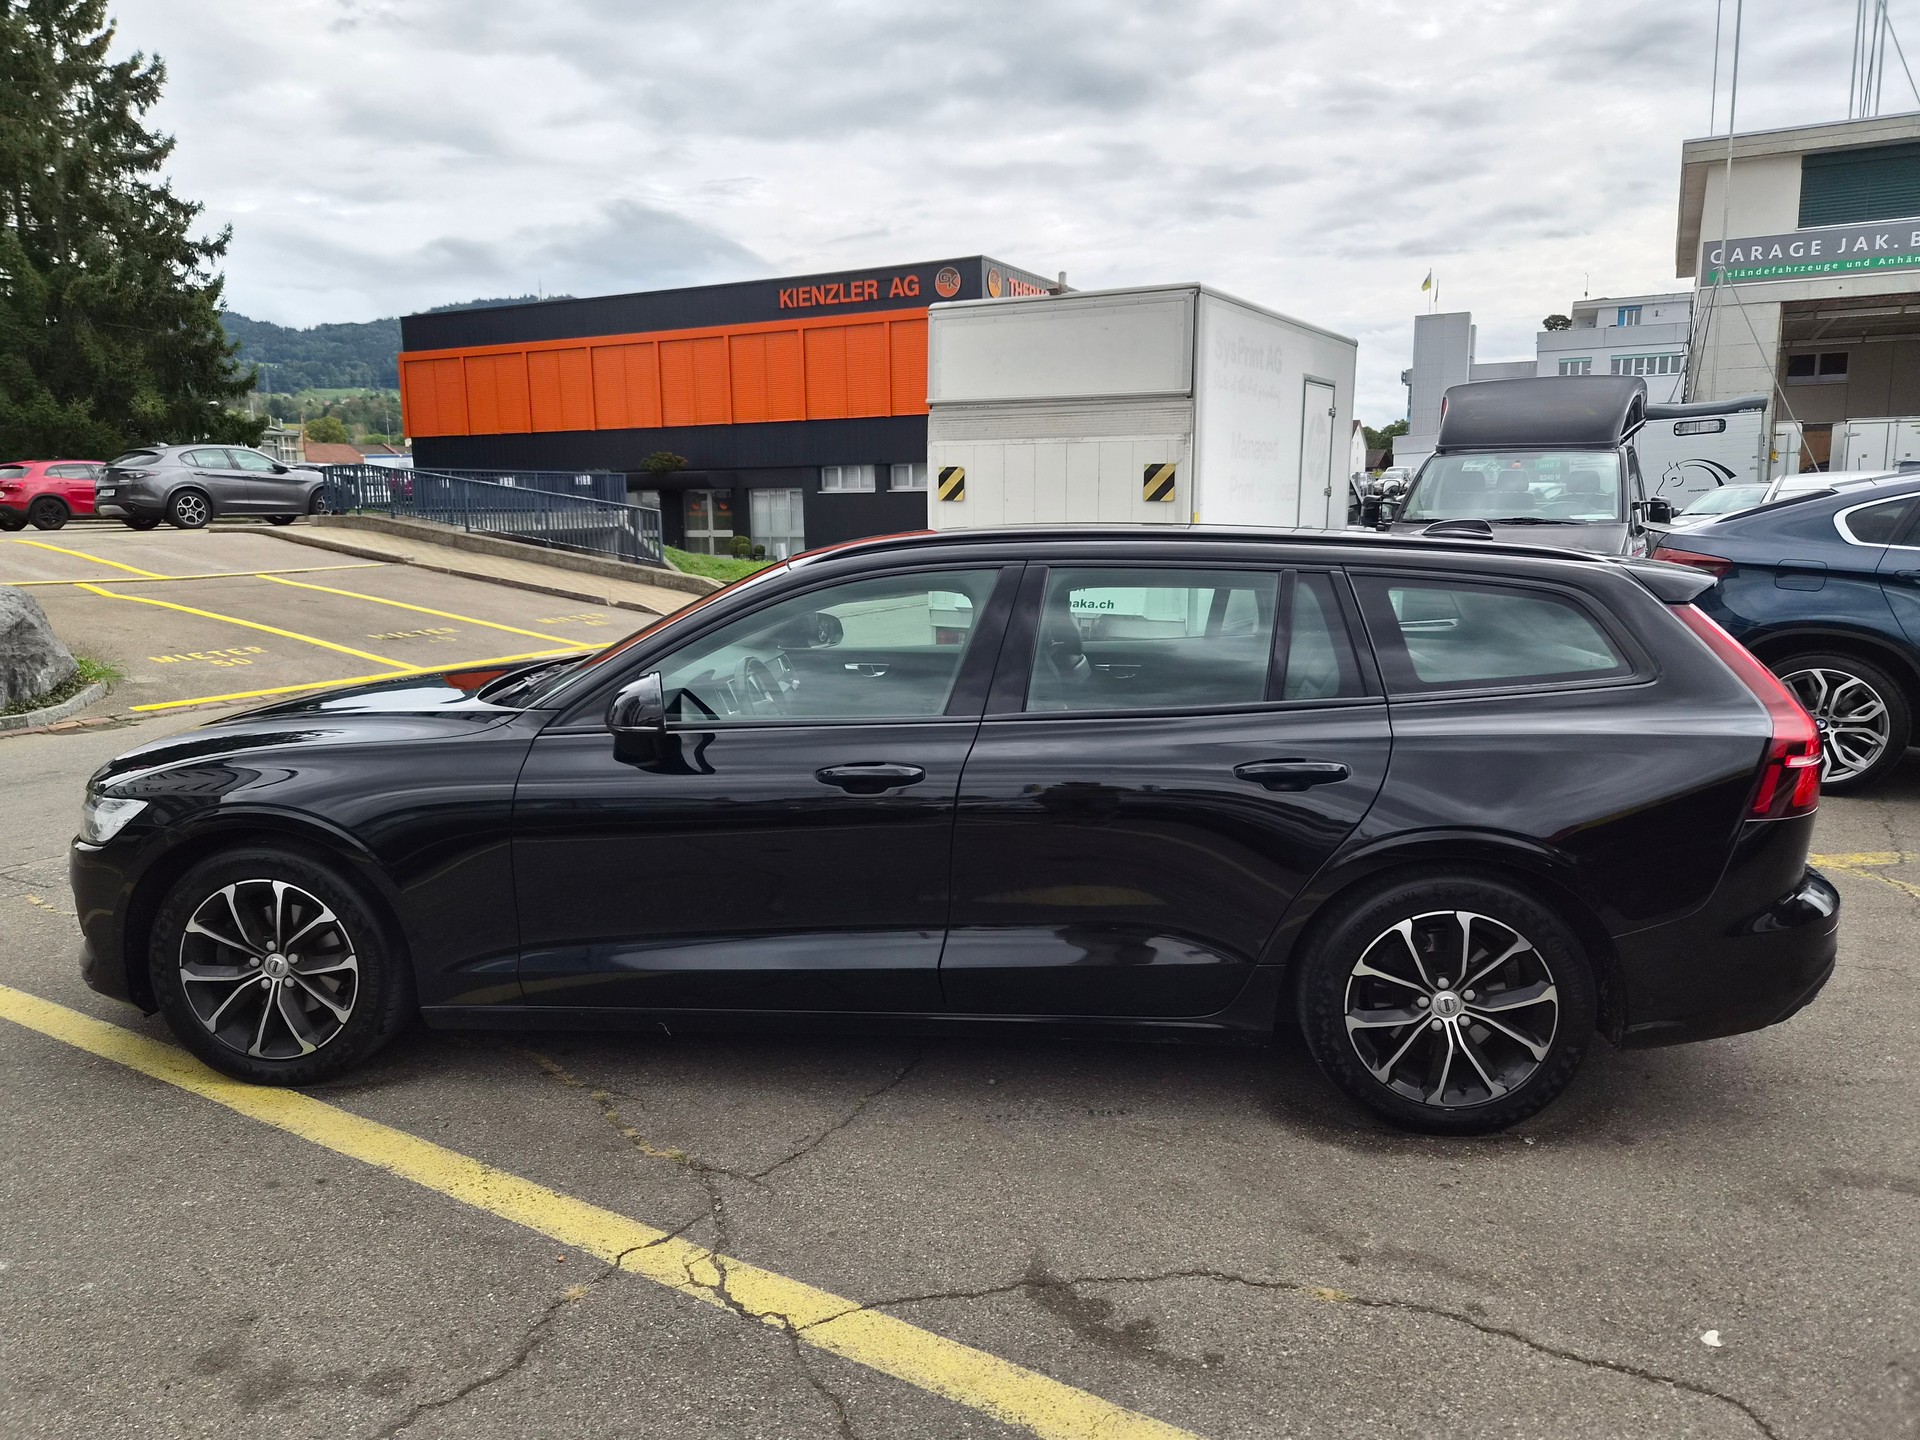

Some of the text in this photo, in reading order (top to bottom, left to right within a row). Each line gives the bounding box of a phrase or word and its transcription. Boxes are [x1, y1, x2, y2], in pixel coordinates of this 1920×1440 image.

[1710, 240, 1822, 264] GARAGE
[1837, 233, 1899, 254] JAK.
[1726, 262, 1839, 278] eländefahrzeuge
[1846, 258, 1870, 268] und
[779, 275, 920, 309] KIENZLER AG
[1265, 344, 1283, 375] AG
[366, 627, 461, 641] MIETER
[147, 646, 269, 664] MIETER
[209, 657, 253, 667] 50
